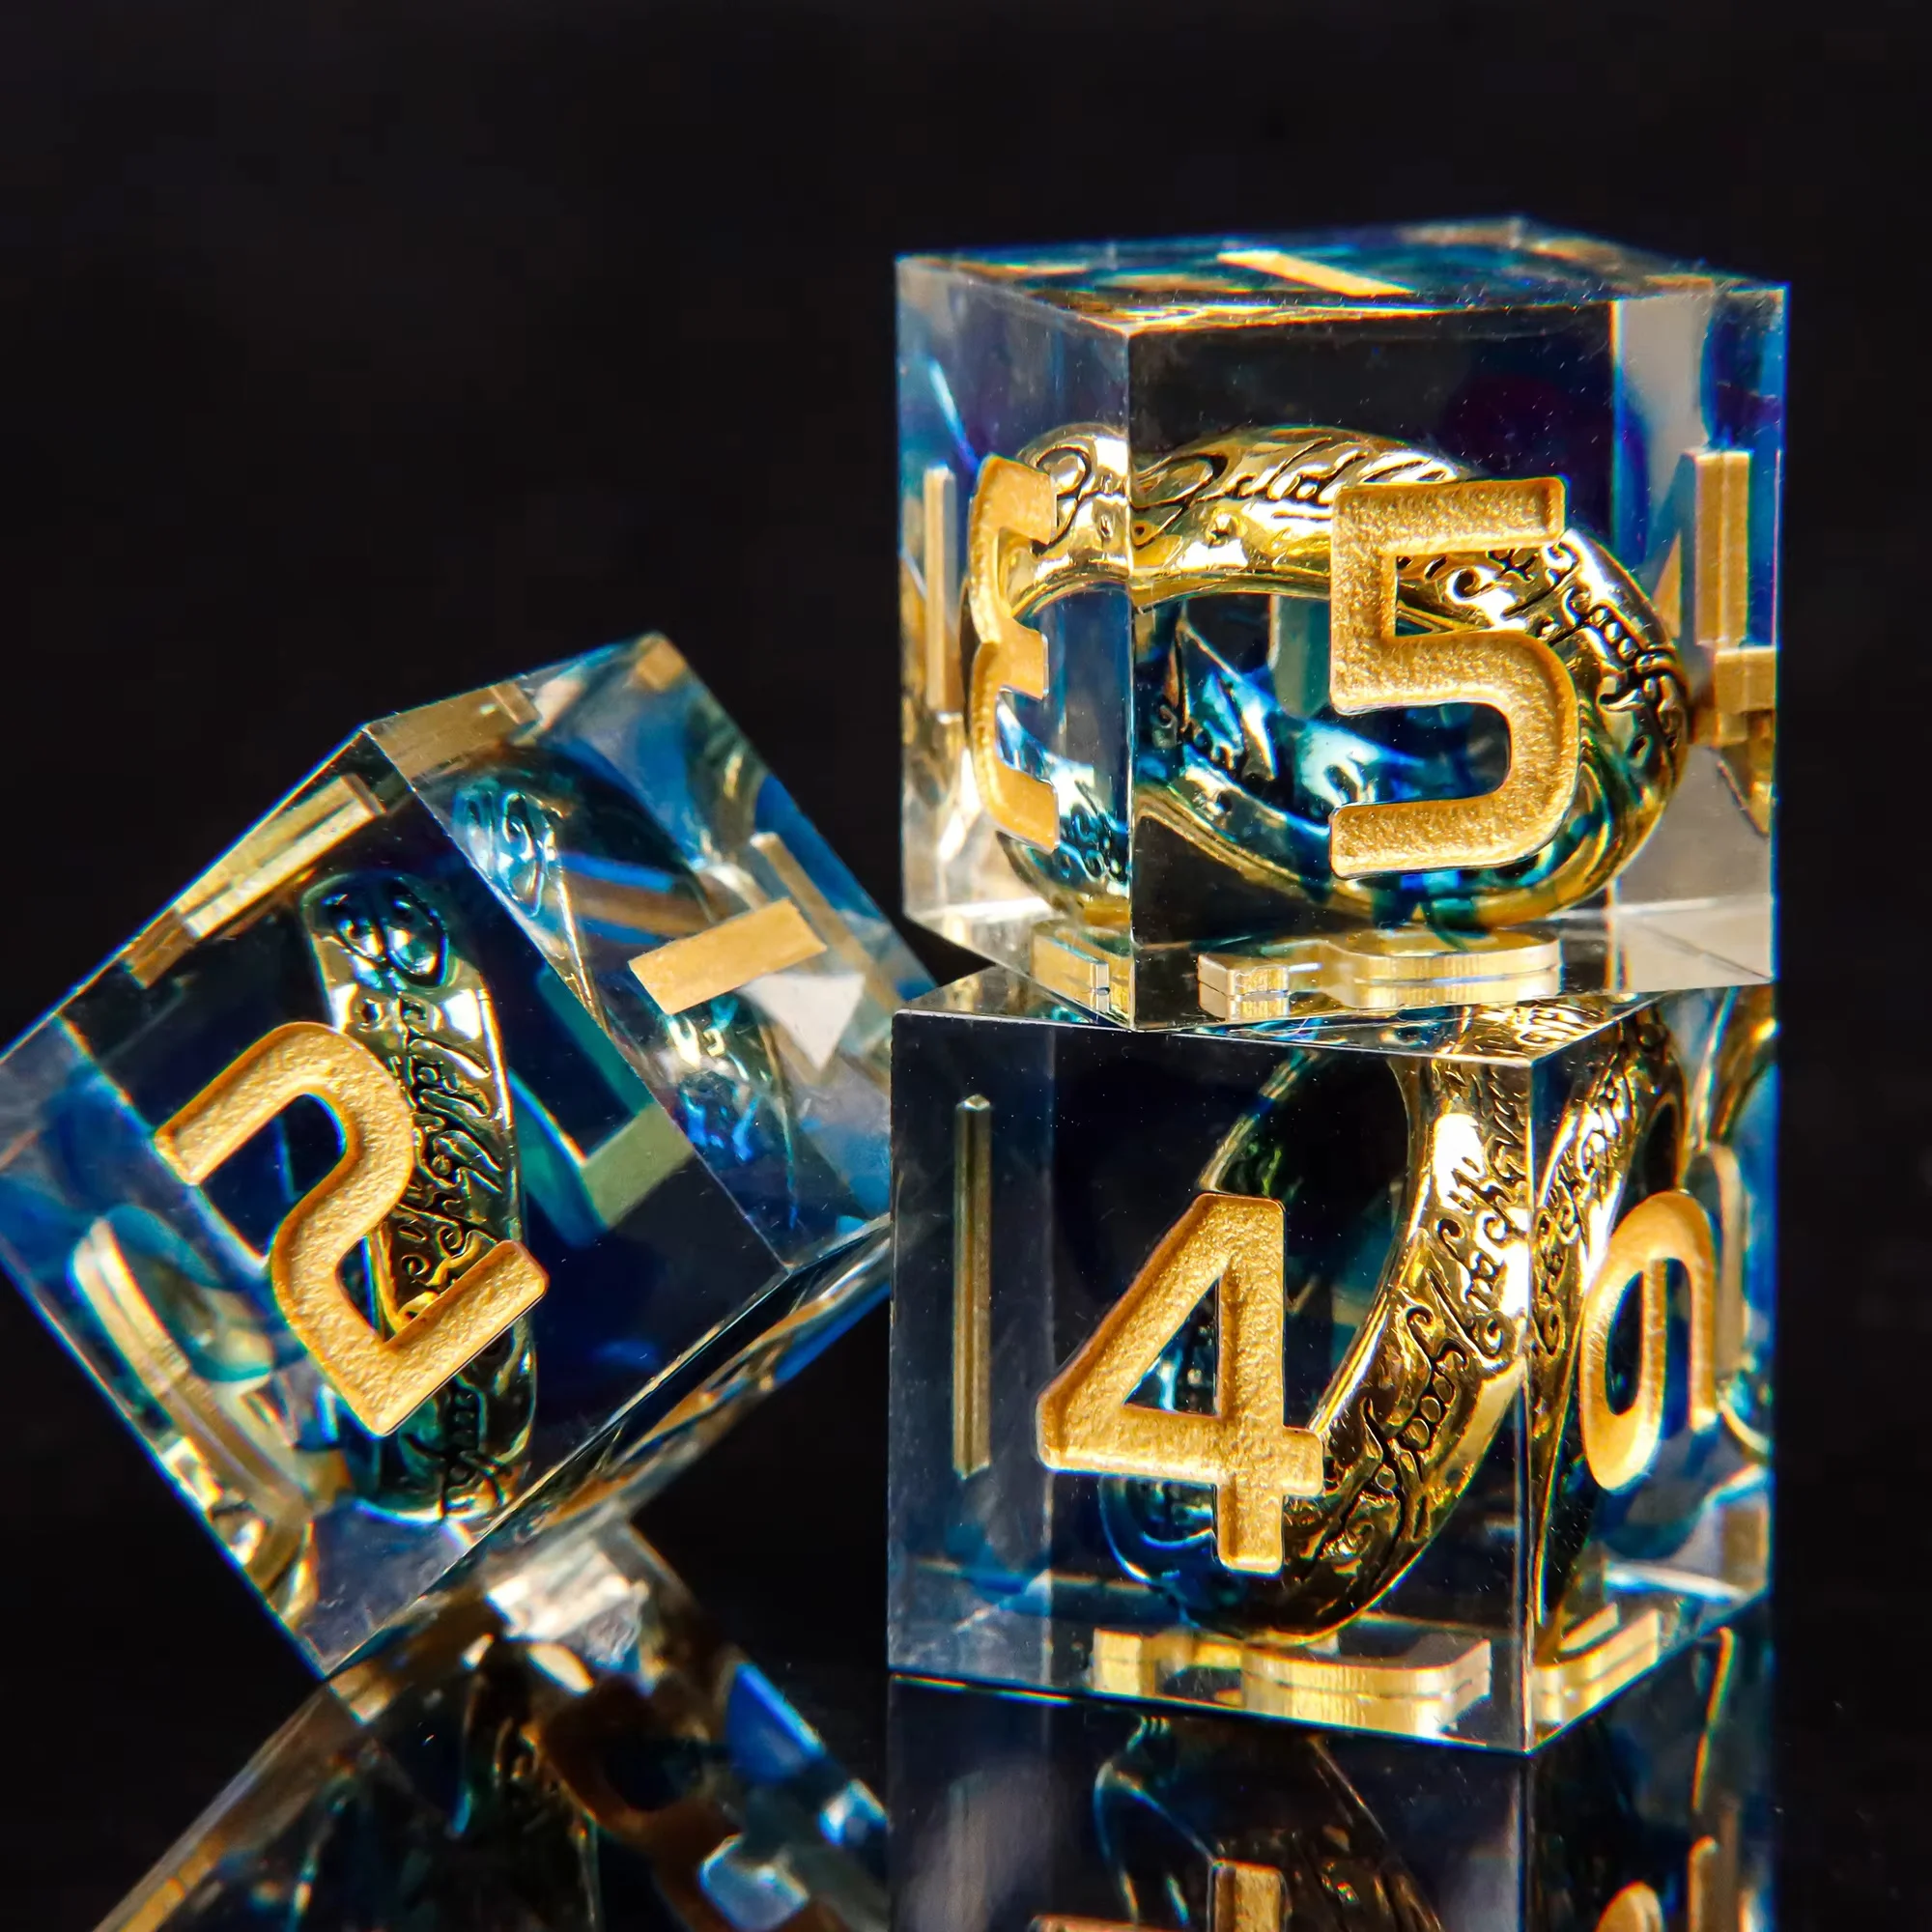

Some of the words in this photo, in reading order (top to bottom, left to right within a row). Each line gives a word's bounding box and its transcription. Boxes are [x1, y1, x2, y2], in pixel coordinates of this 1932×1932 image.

[1330, 476, 1577, 877] 5
[155, 1021, 548, 1435] 2
[1037, 1194, 1322, 1574] 4
